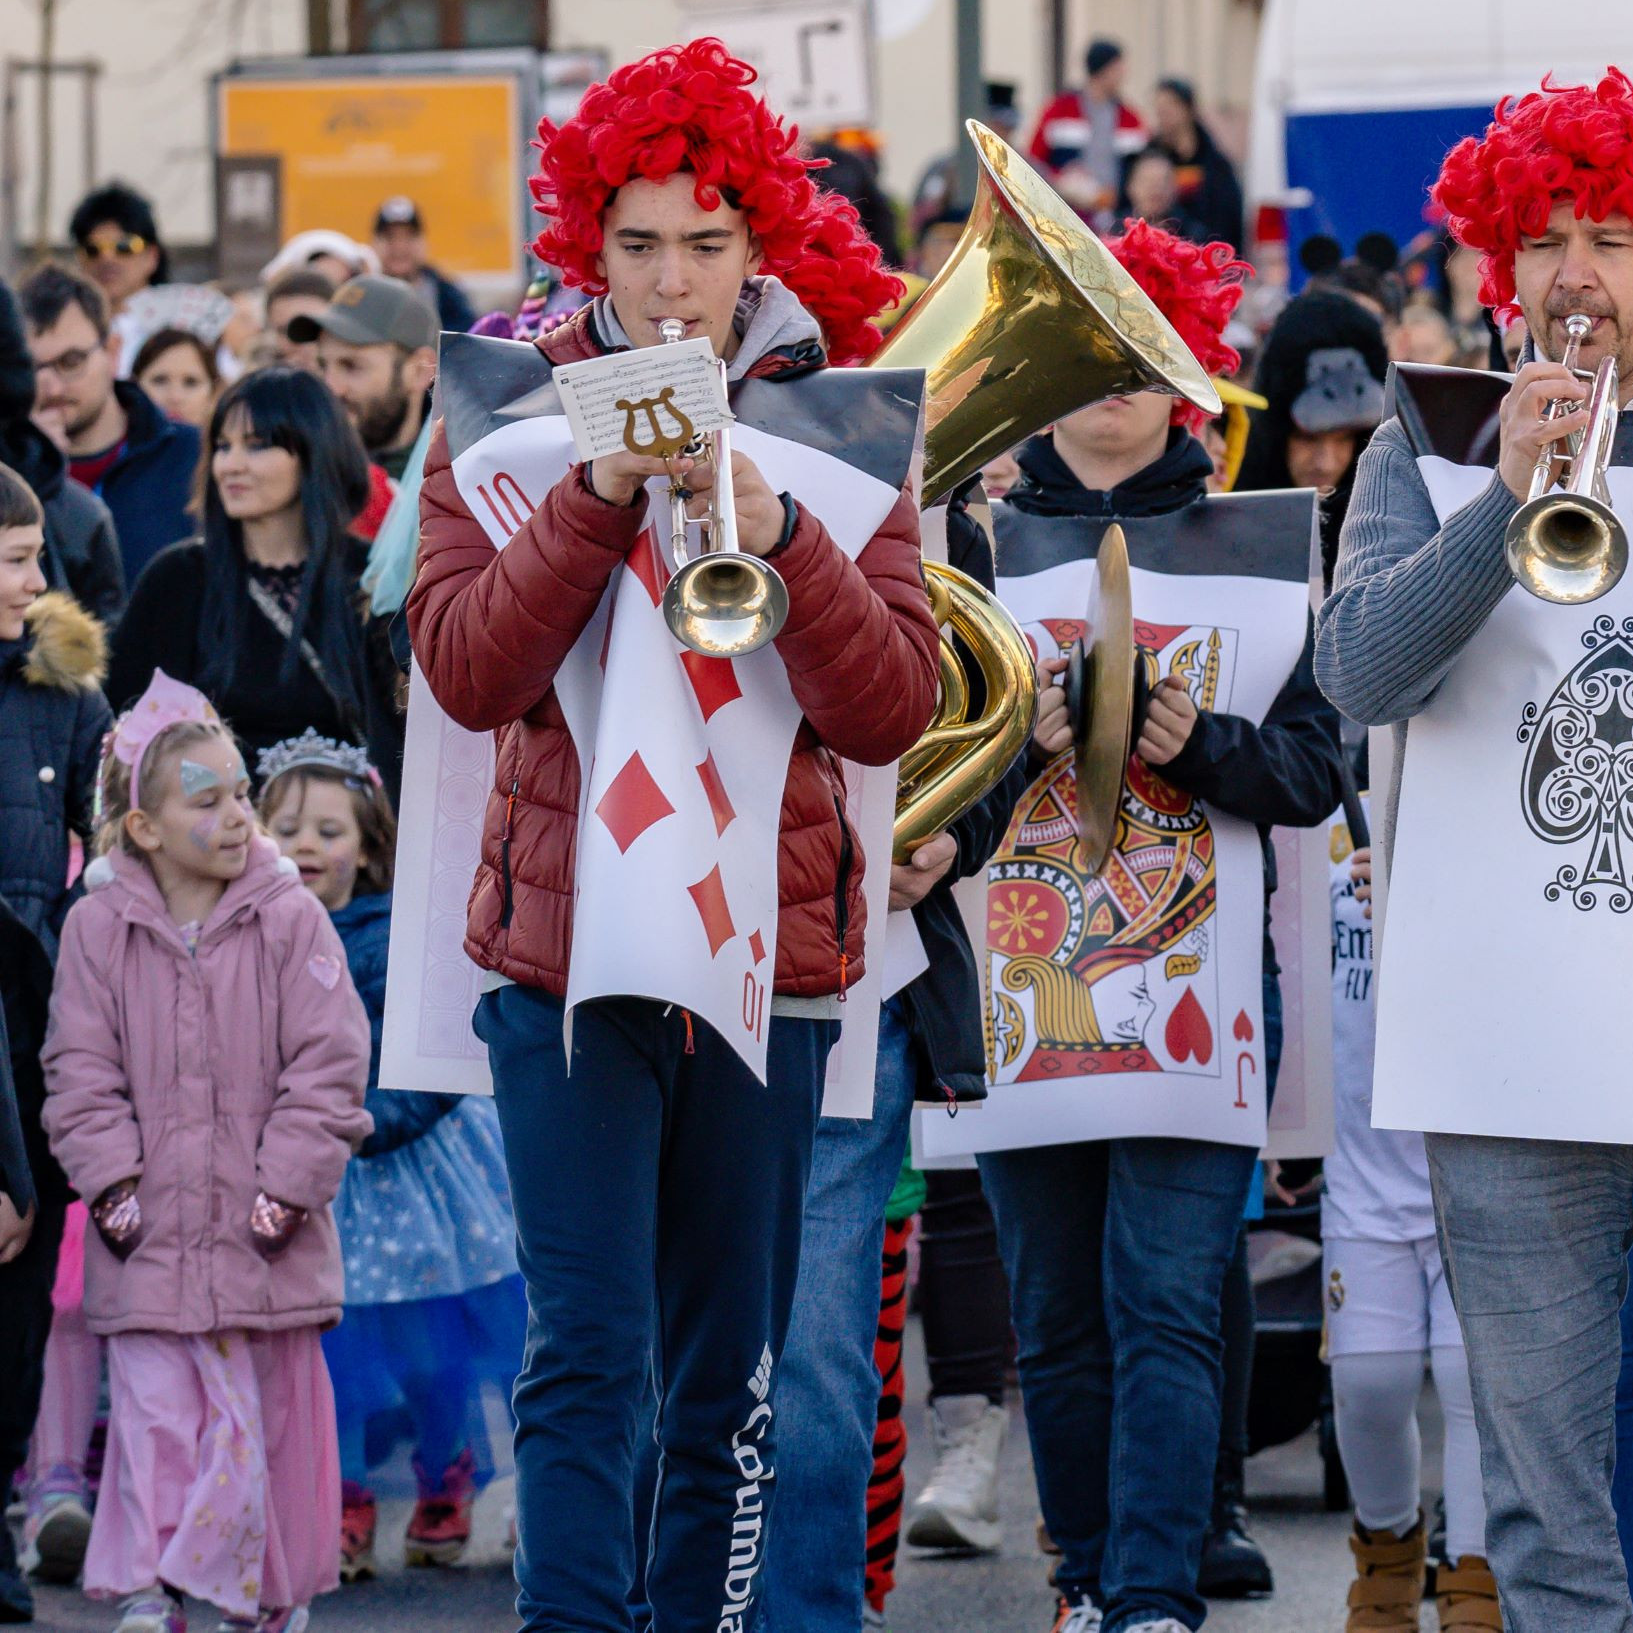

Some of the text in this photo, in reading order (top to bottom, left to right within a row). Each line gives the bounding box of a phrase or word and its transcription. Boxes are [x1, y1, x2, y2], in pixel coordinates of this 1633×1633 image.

[742, 971, 764, 1043] 10
[1233, 1051, 1256, 1109] J
[716, 1402, 775, 1633] Columbia
